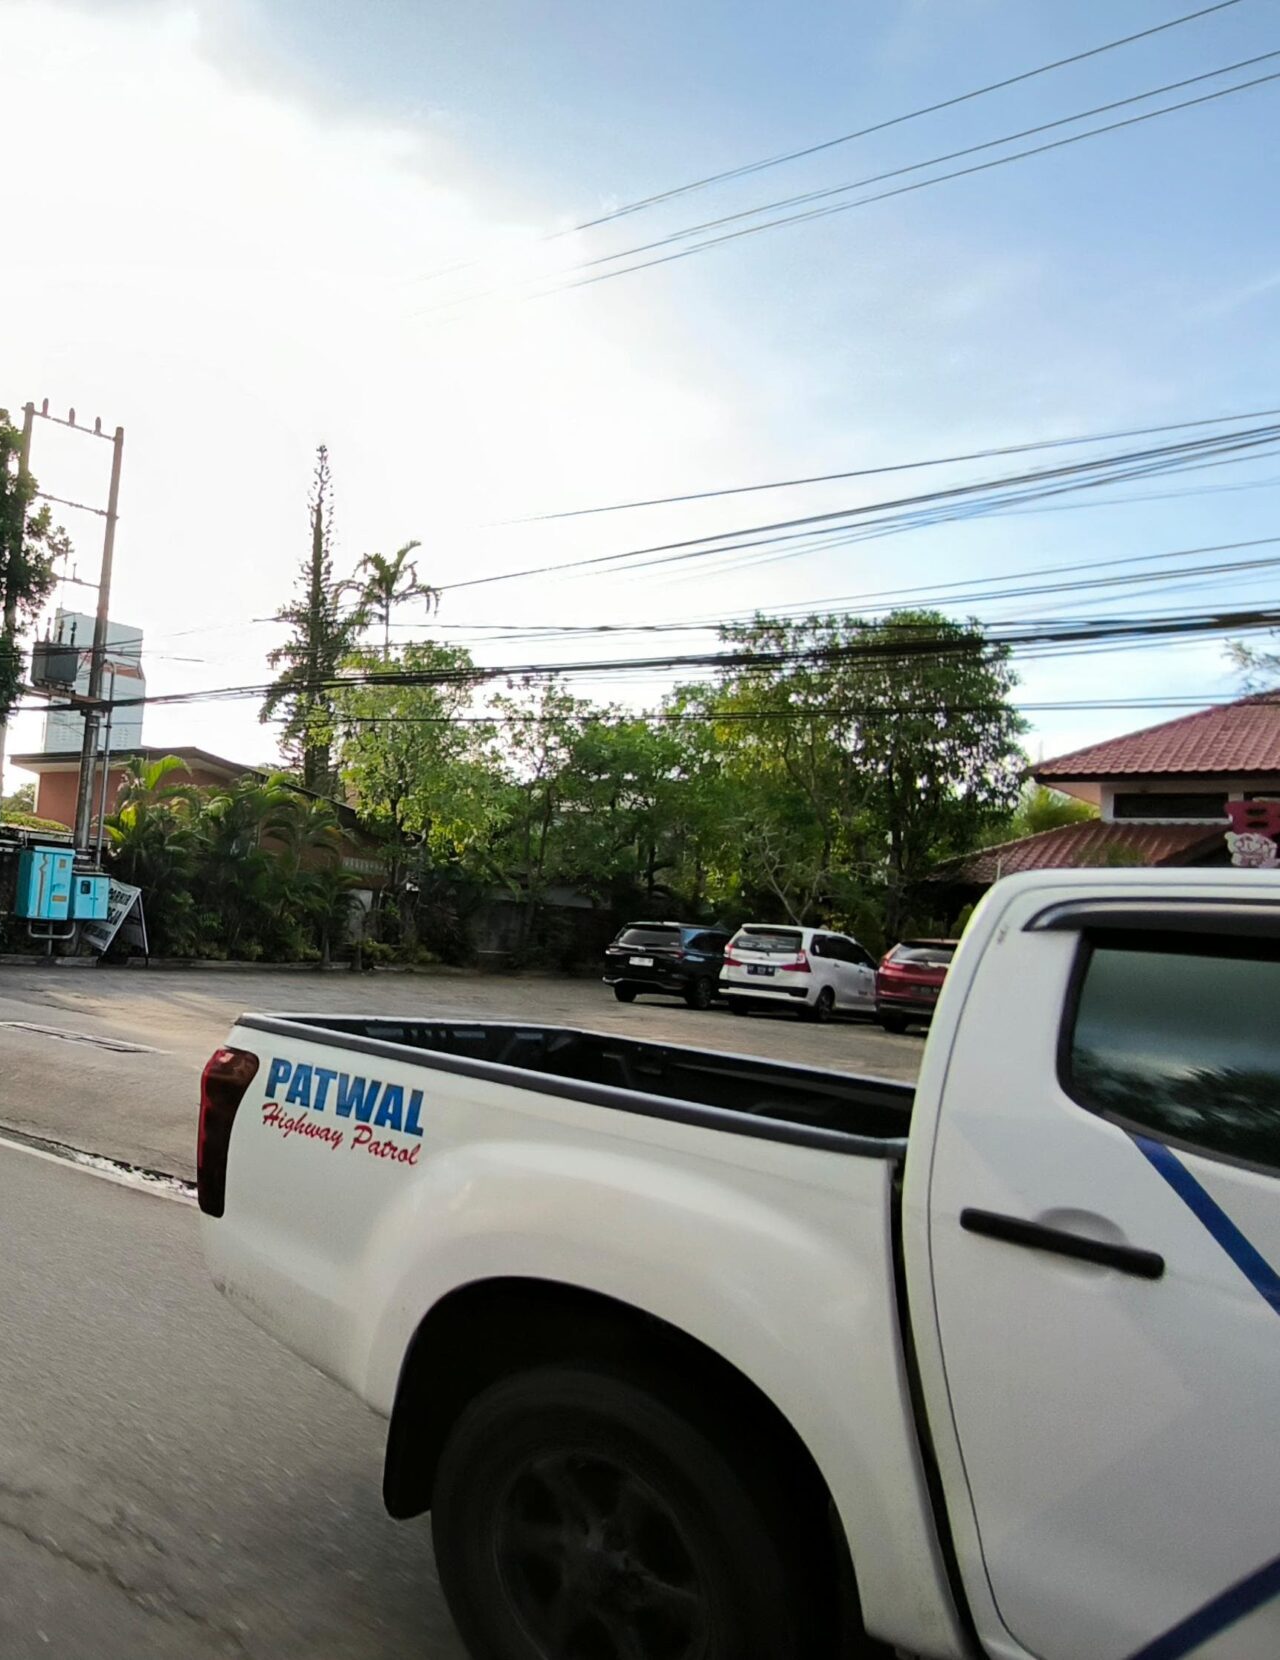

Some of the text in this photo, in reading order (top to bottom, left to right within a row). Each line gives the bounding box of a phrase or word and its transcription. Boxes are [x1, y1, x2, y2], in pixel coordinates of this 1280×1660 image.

[265, 1058, 424, 1137] PATWAL
[261, 1102, 422, 1166] Highway Patrol
